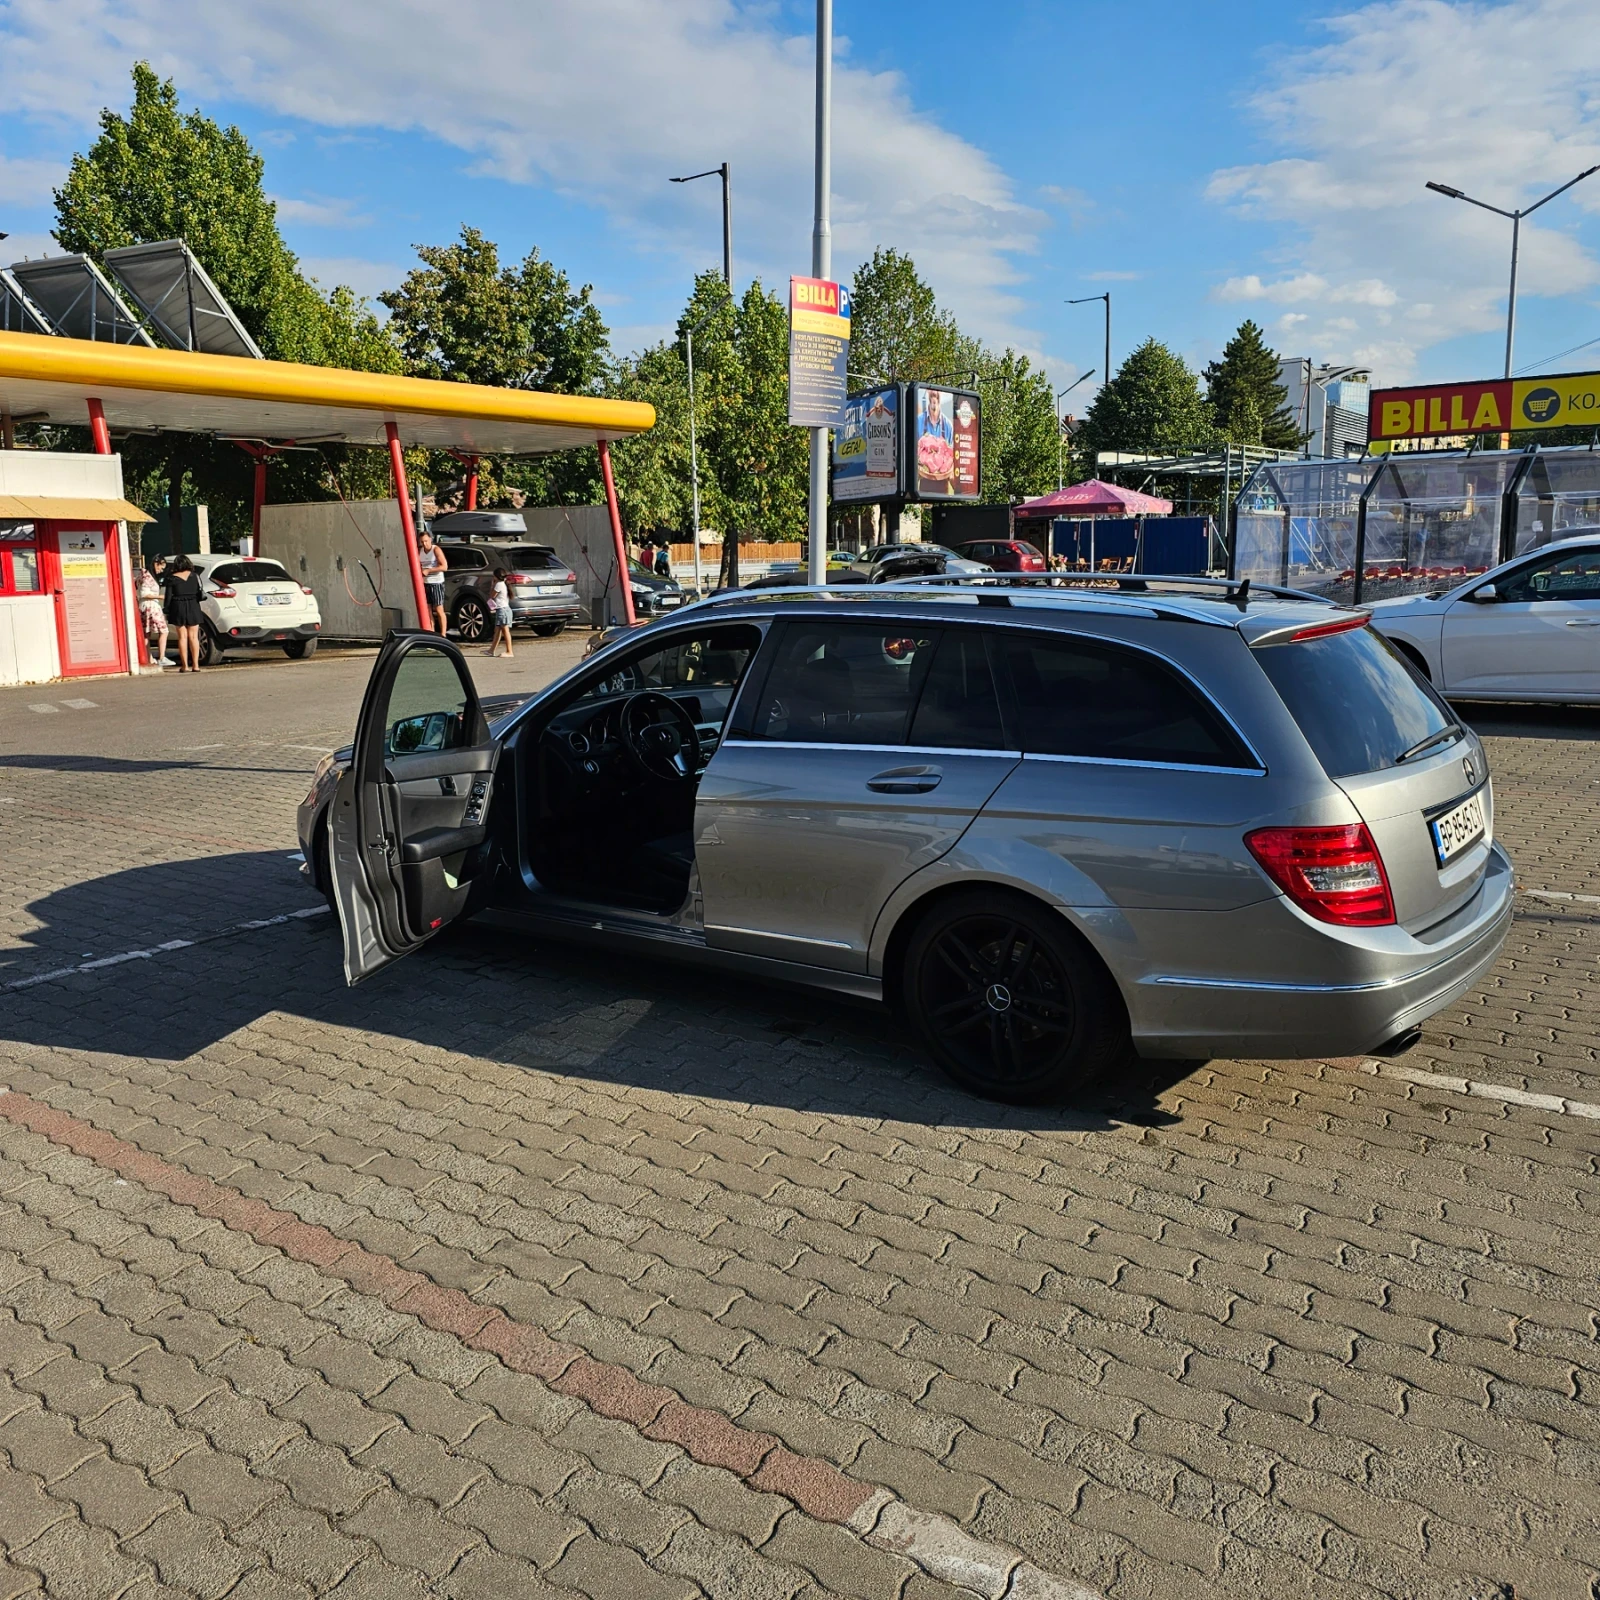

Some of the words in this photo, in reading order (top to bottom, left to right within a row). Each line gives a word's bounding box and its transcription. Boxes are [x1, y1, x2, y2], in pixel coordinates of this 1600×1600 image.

[796, 283, 837, 308] BILLA
[840, 290, 848, 312] P
[1568, 393, 1600, 410] КО
[1381, 392, 1502, 436] BILLA
[867, 422, 891, 439] GIBSON'S
[841, 439, 862, 456] СЕГА!
[874, 447, 885, 456] GIN
[1055, 493, 1094, 502] Raffy
